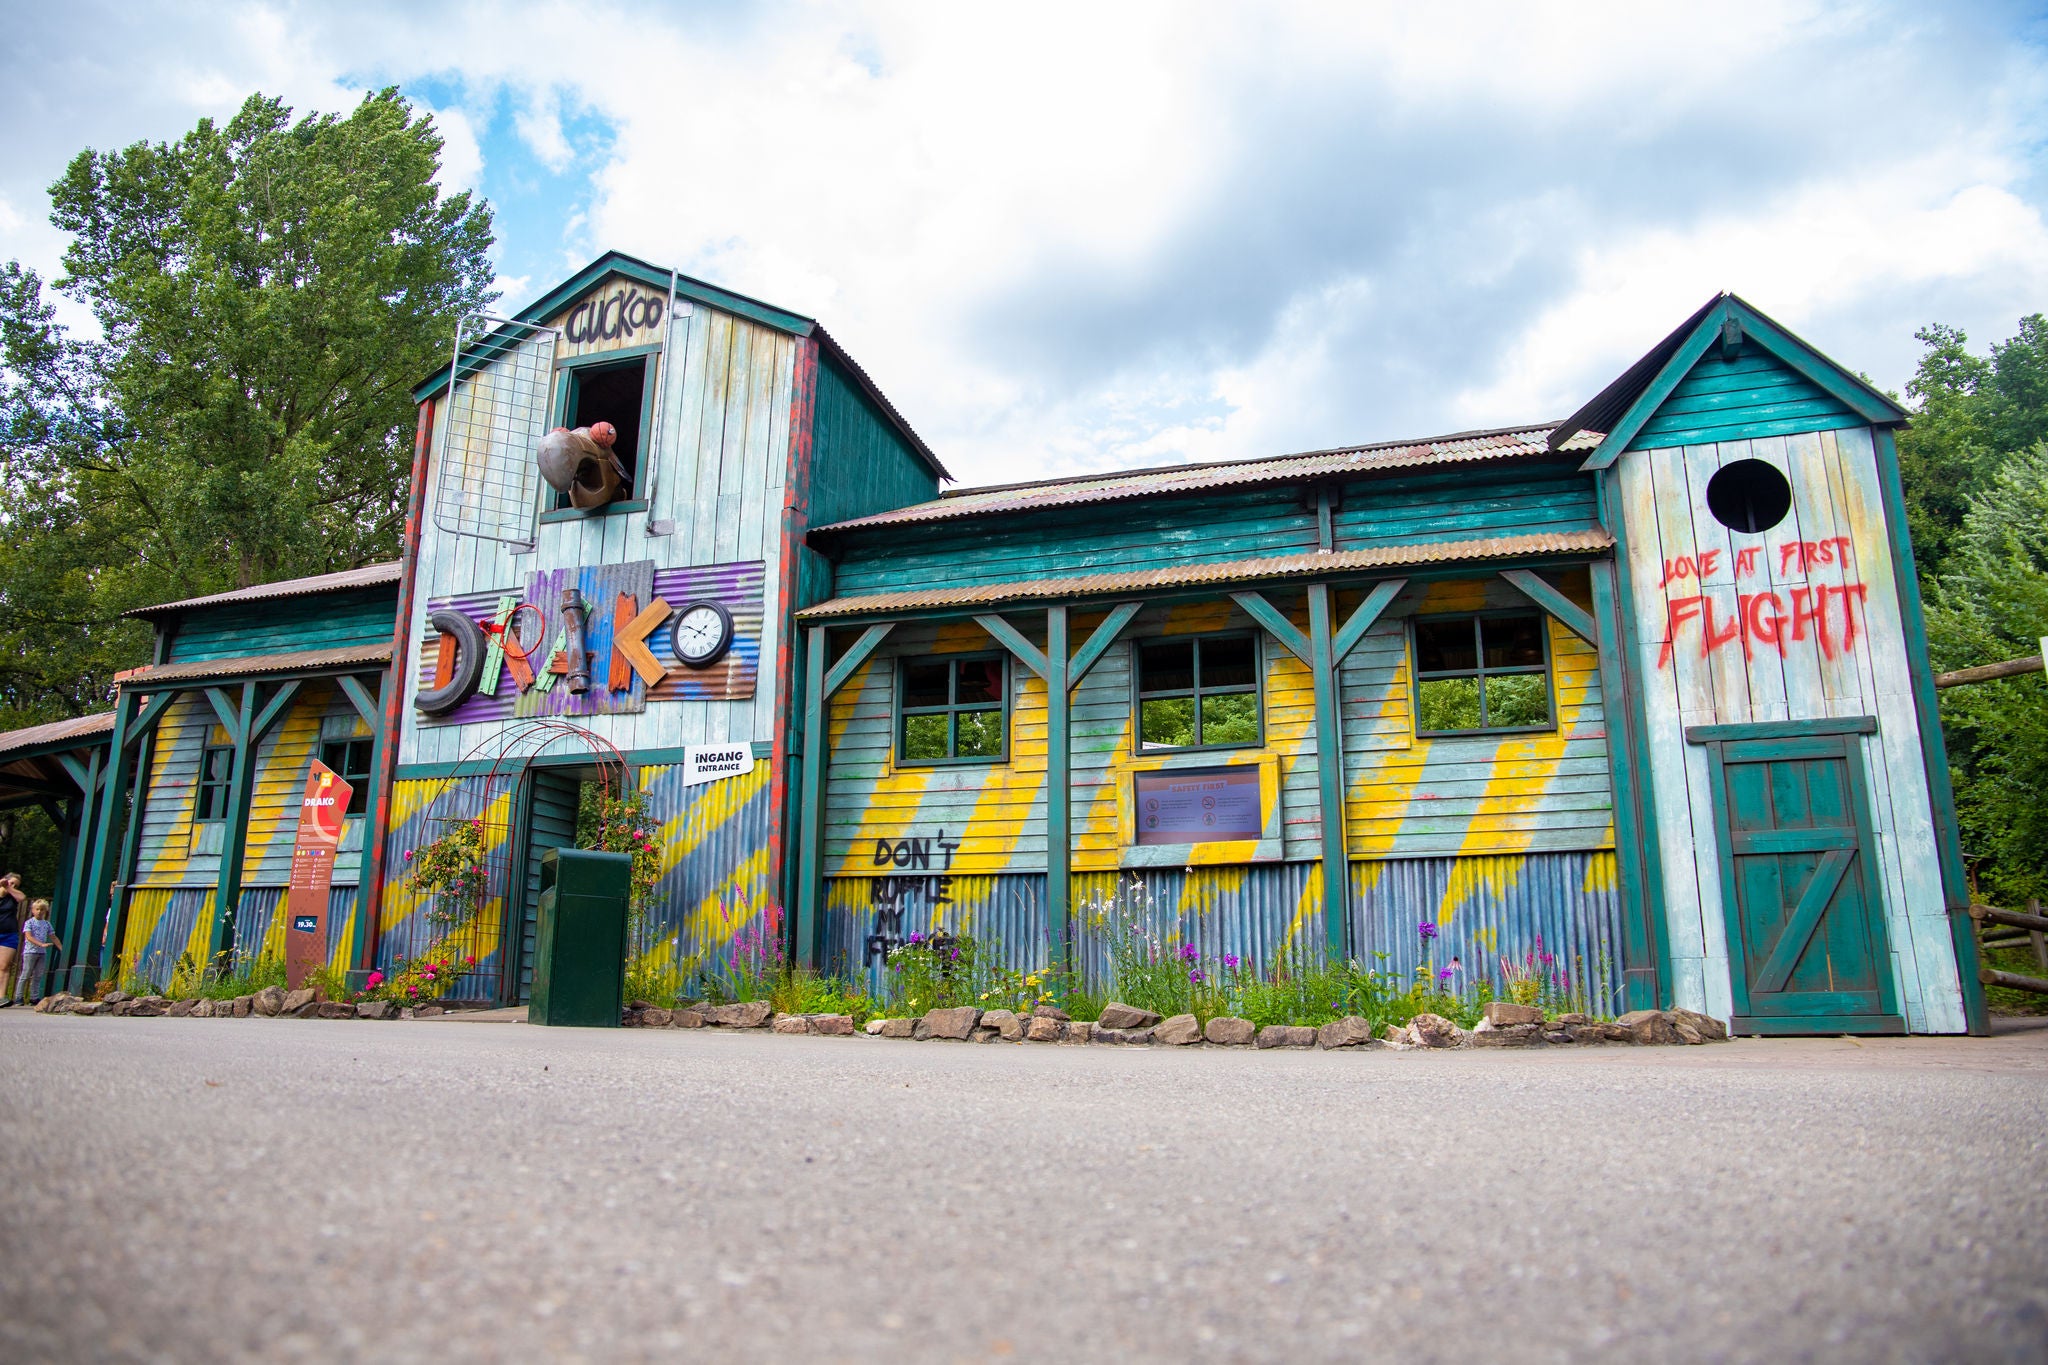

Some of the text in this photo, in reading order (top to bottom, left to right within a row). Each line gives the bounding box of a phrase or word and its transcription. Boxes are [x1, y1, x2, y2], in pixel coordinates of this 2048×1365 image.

[565, 288, 664, 344] CUCKOO
[1659, 536, 1851, 589] LOVE AT FIRST
[1657, 582, 1868, 670] FLIGHT
[414, 588, 735, 715] DRAKO
[697, 763, 740, 772] ENTRANCE
[304, 797, 335, 806] DRAKO
[873, 829, 960, 871] DON'T
[870, 876, 954, 904] RUFFLE
[876, 907, 906, 934] MY
